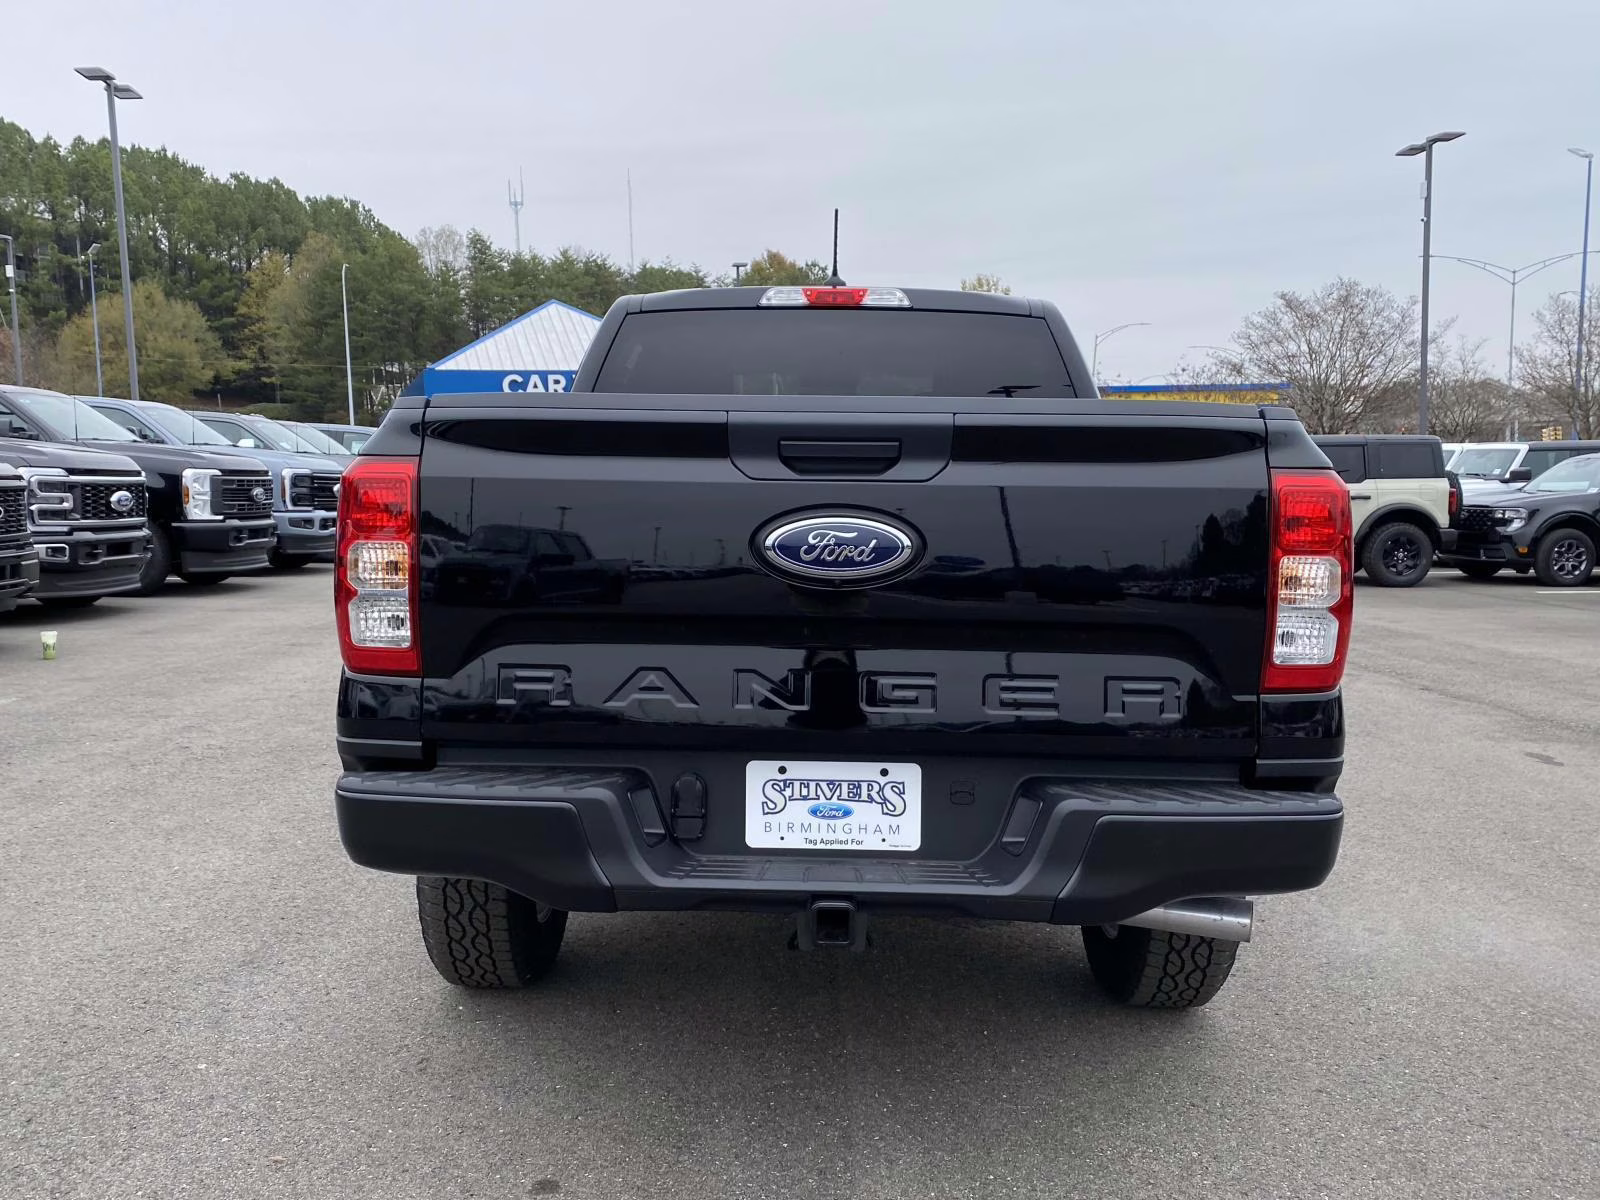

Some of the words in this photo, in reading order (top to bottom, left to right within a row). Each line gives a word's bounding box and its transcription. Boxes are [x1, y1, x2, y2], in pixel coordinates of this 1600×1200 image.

[502, 374, 566, 392] CAR
[800, 529, 878, 562] Ford
[497, 663, 1183, 717] RANGER
[762, 778, 906, 817] STIVERS
[815, 805, 844, 818] Ford
[764, 821, 900, 836] BIRMINGHAM
[804, 837, 818, 846] Tag
[819, 838, 848, 846] Applied
[850, 838, 864, 846] For
